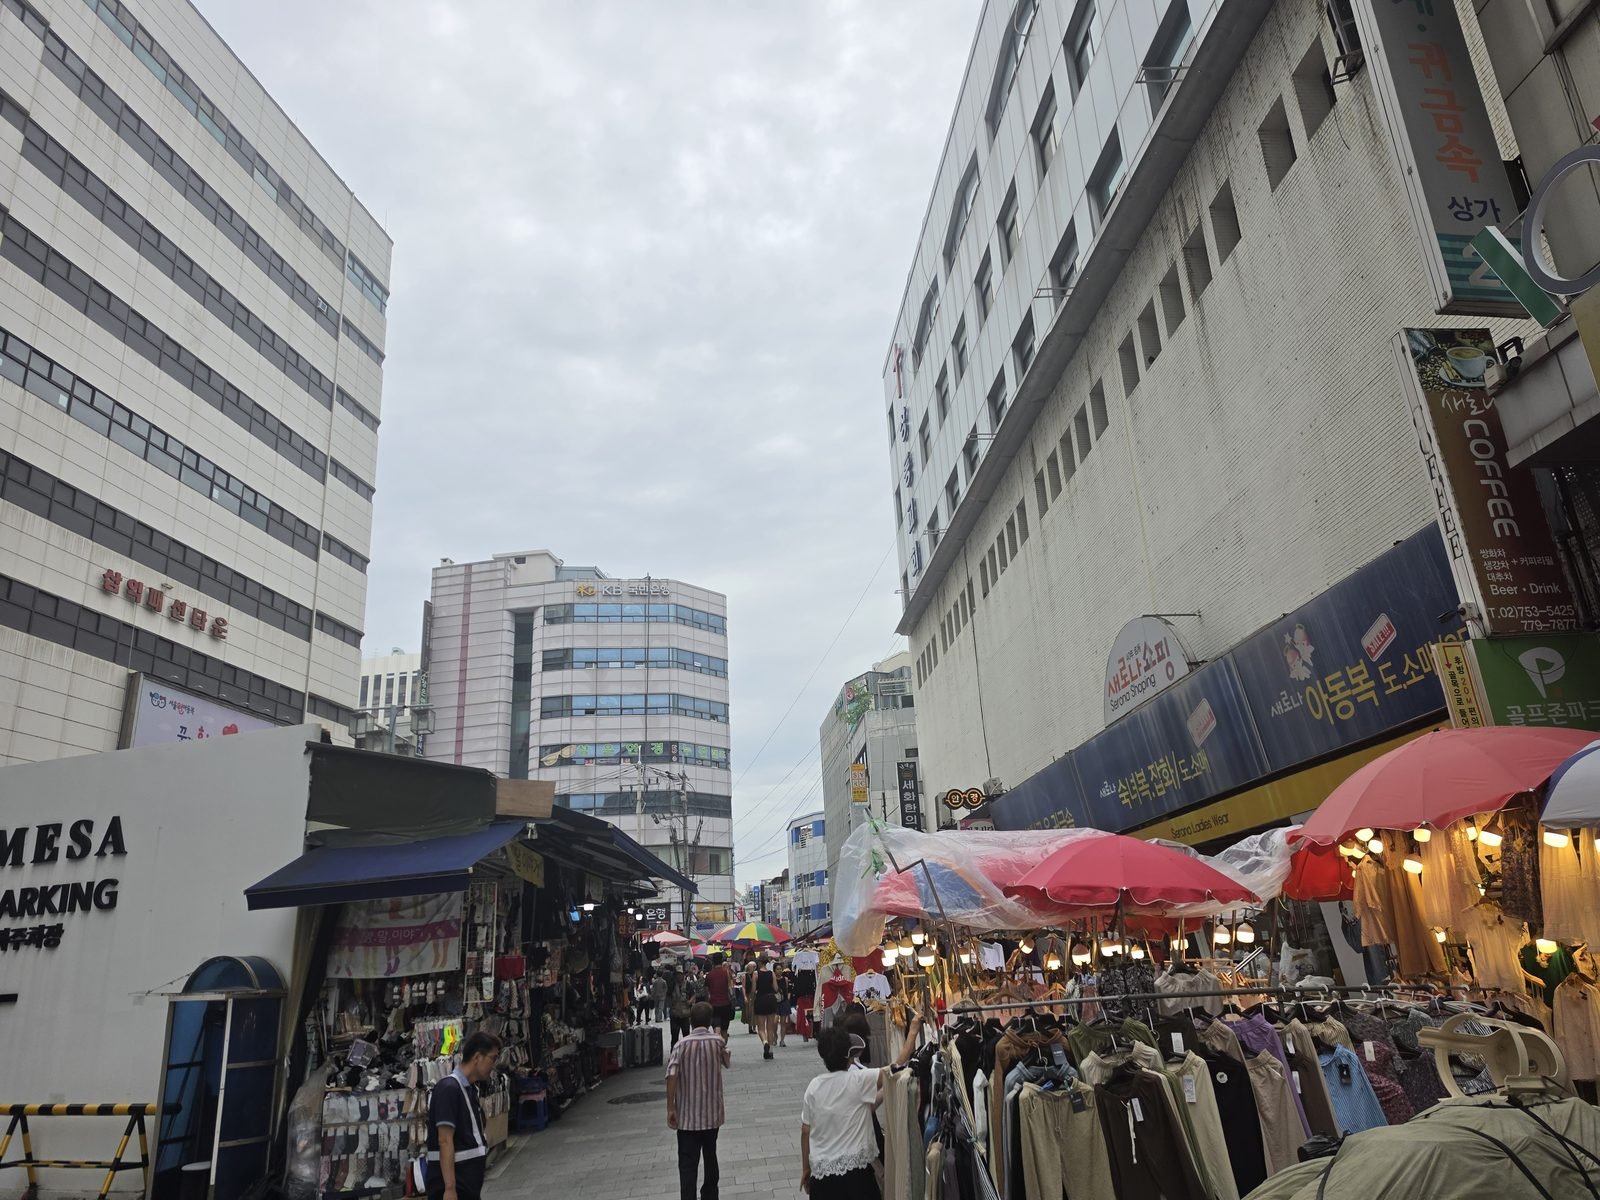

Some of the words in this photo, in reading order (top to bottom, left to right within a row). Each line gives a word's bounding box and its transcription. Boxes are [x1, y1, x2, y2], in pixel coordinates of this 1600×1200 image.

[1448, 196, 1500, 223] 상가
[1463, 419, 1521, 538] COFFEE
[1479, 549, 1506, 559] 쌍화차
[1484, 561, 1510, 571] 생강차
[1487, 573, 1513, 582] 대추차
[602, 585, 623, 596] KB
[628, 585, 670, 596] 국민은행
[1490, 584, 1518, 596] Beer
[1529, 583, 1561, 595] Drink
[103, 568, 229, 640] 삼익패션타운
[1521, 619, 1577, 631] 779-7877
[1110, 692, 1130, 711] Serona
[1130, 673, 1156, 698] Shoping
[1271, 690, 1303, 718] 새로나
[1305, 658, 1380, 726] 아동복
[1100, 781, 1117, 798] 새로나
[902, 780, 918, 830] 세화한의
[951, 793, 978, 804] 안경
[1170, 825, 1193, 840] Serona
[1192, 818, 1213, 834] Ladies
[1212, 812, 1229, 828] Wear
[0, 816, 128, 868] MESA
[646, 907, 666, 920] 은행
